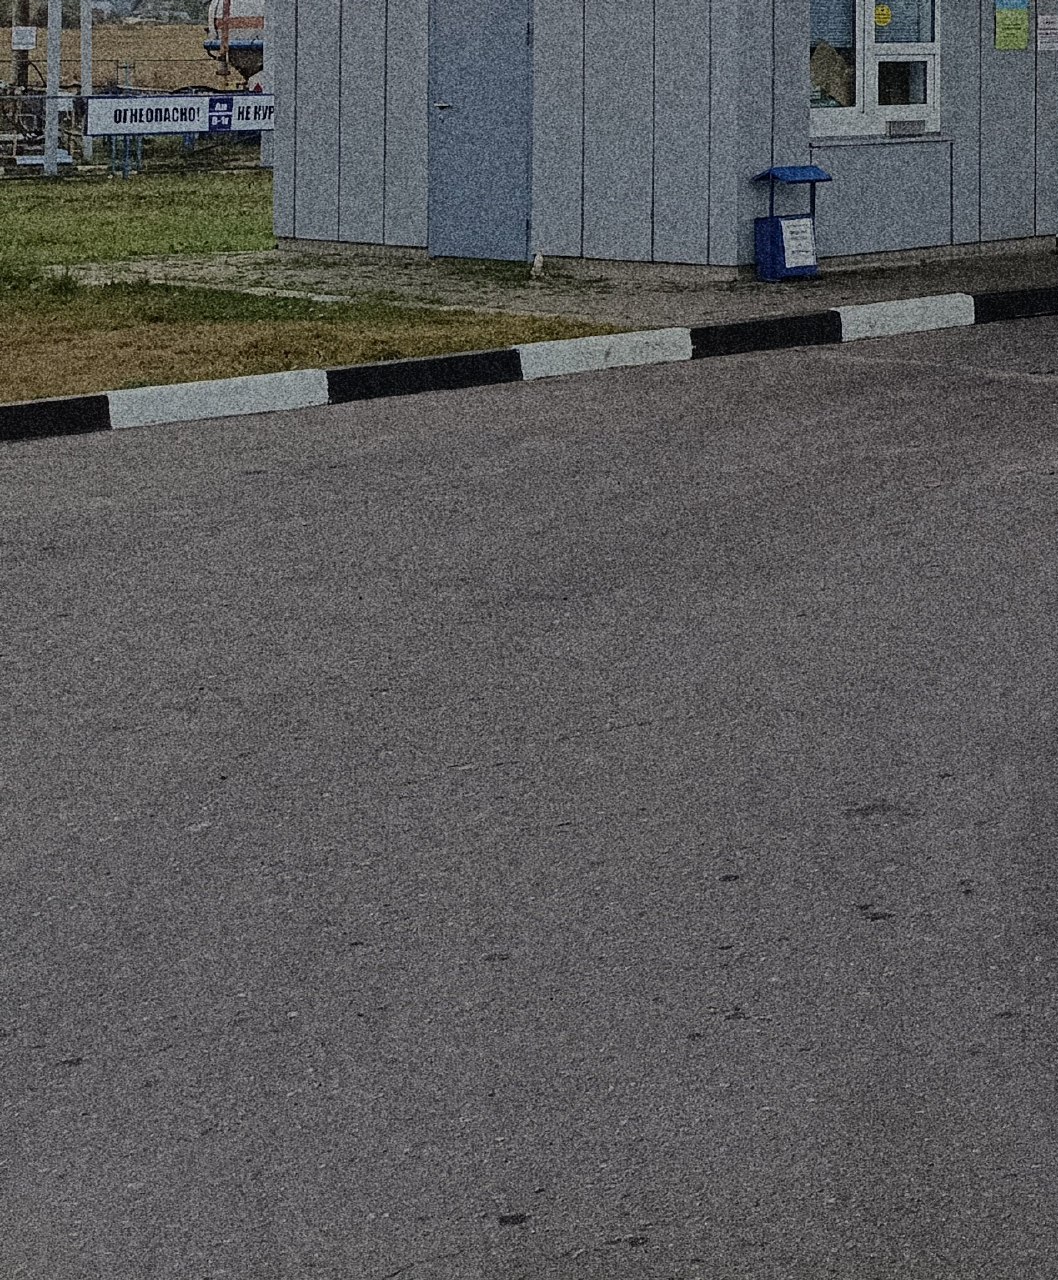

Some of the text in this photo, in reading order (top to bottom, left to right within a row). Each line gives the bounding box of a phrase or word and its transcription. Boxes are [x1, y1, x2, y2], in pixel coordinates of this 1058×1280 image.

[114, 106, 200, 124] ОГНЕОПАСНО!
[237, 105, 274, 120] НЕ КУР
